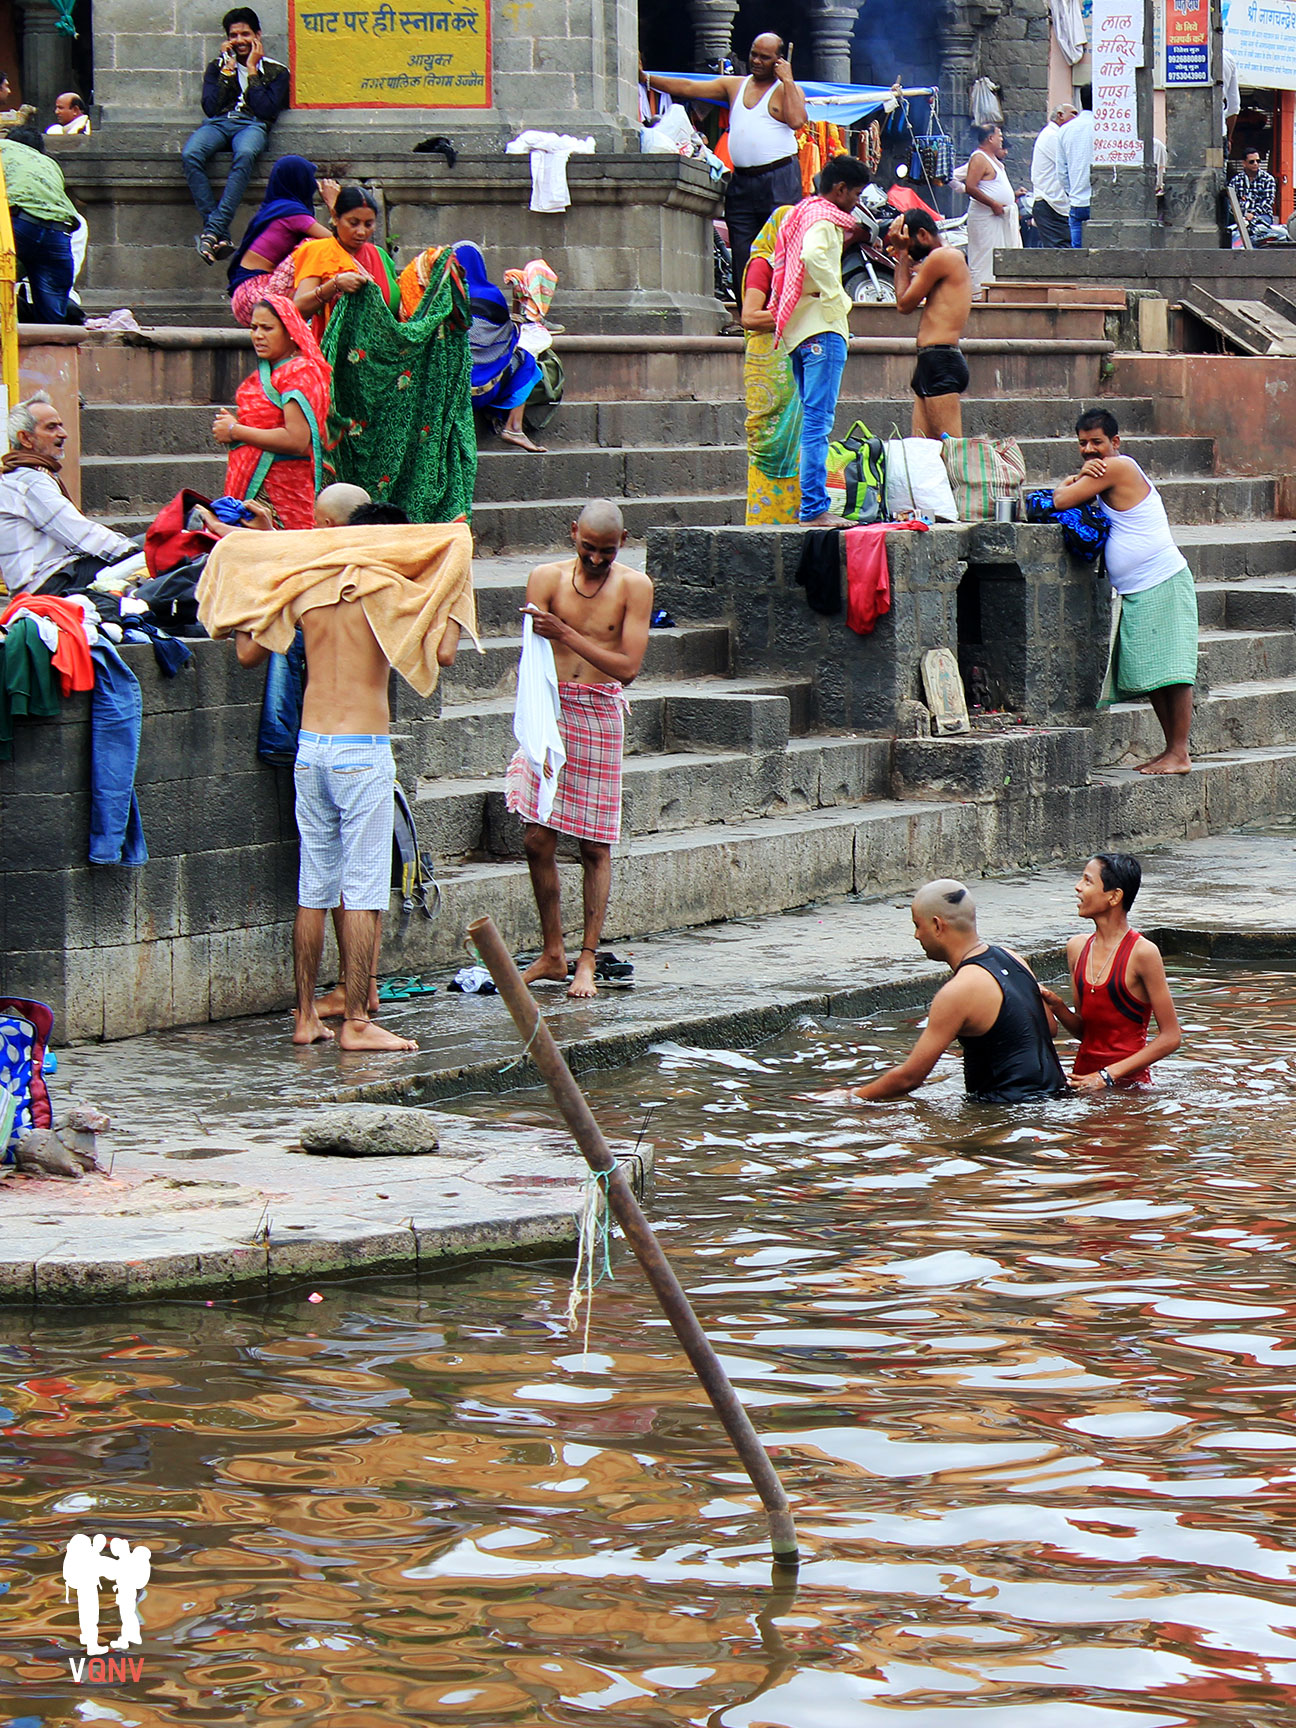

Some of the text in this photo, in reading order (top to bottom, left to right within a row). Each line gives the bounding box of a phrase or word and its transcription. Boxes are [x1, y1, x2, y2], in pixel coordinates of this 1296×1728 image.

[301, 3, 479, 37] घाट पर ही स्नान करें
[1248, 0, 1257, 24] श्री
[1101, 15, 1133, 32] लाल
[1096, 34, 1137, 57] मन्दिर
[407, 54, 453, 71] आयुक्त
[1100, 57, 1127, 77] वाले
[1098, 85, 1131, 99] पण्डा
[1094, 108, 1132, 120] 99266
[1094, 122, 1132, 133] 03223
